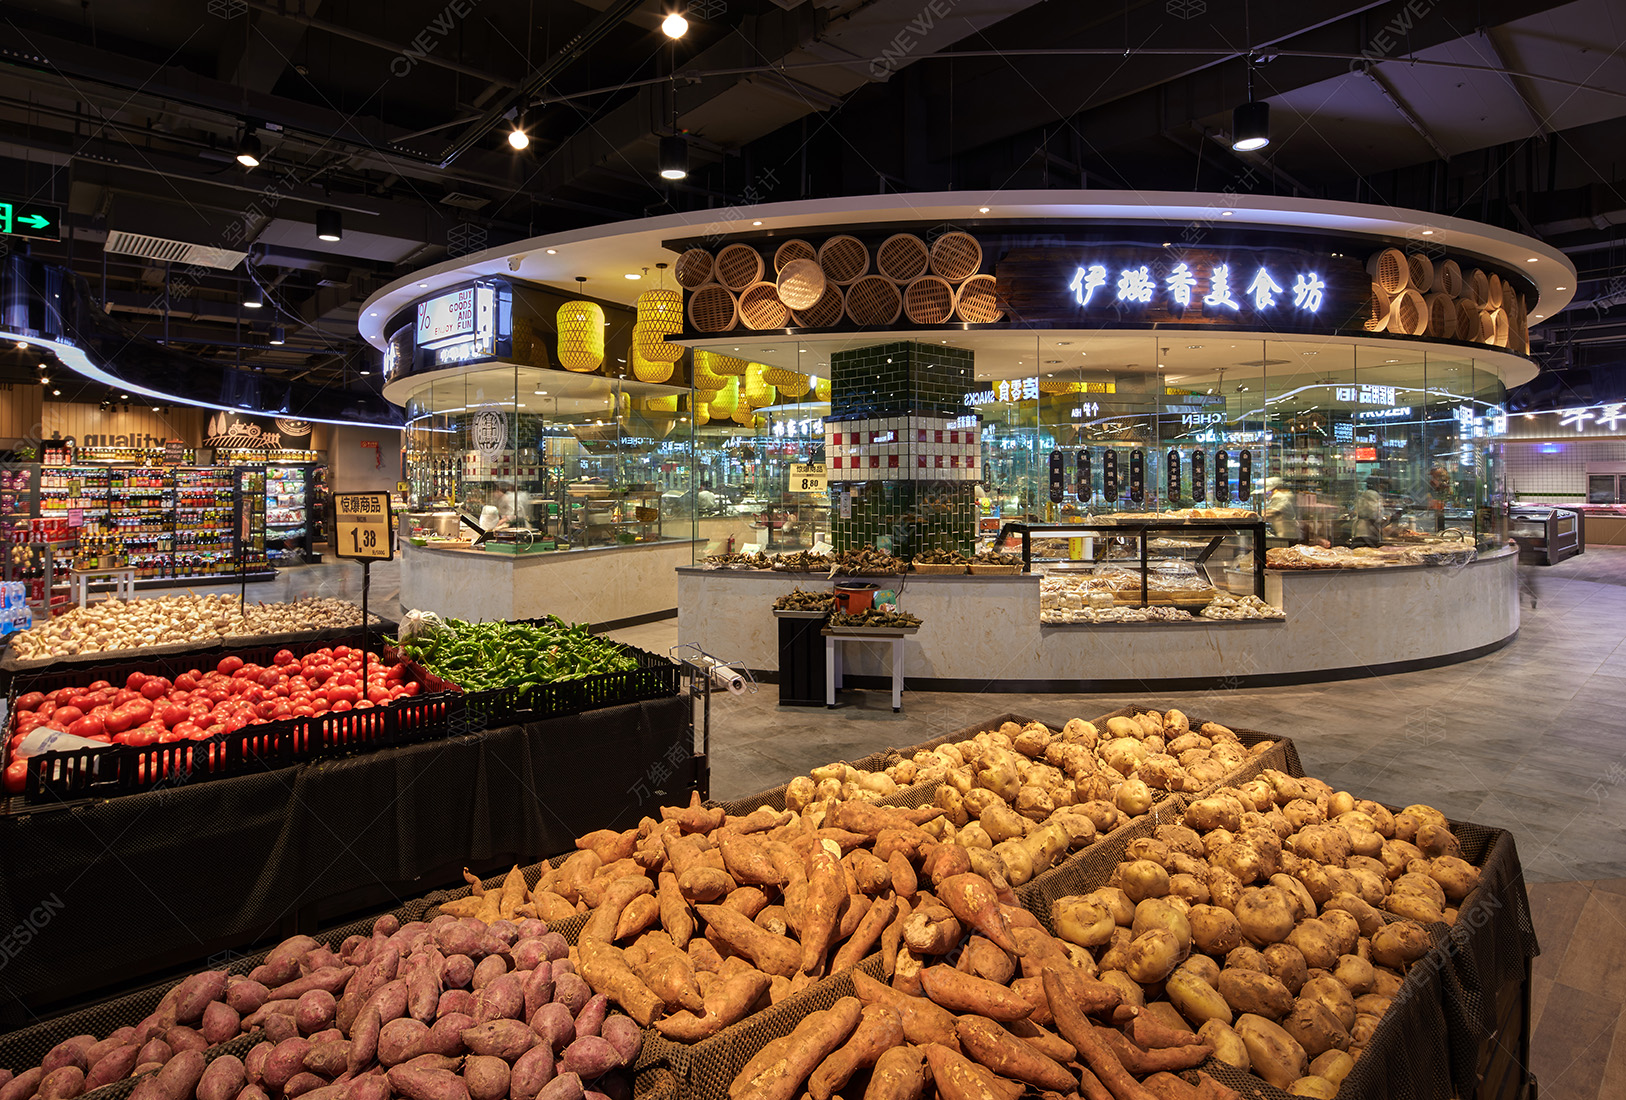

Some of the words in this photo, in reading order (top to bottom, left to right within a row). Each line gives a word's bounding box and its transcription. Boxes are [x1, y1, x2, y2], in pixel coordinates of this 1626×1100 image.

[1069, 261, 1327, 313] 伊璐香美食坊
[458, 289, 473, 302] BUY
[448, 299, 472, 313] GOODS
[457, 309, 472, 321] AND
[457, 319, 472, 331] FUN
[340, 496, 381, 513] 惊爆商品
[350, 527, 377, 553] 1.38
